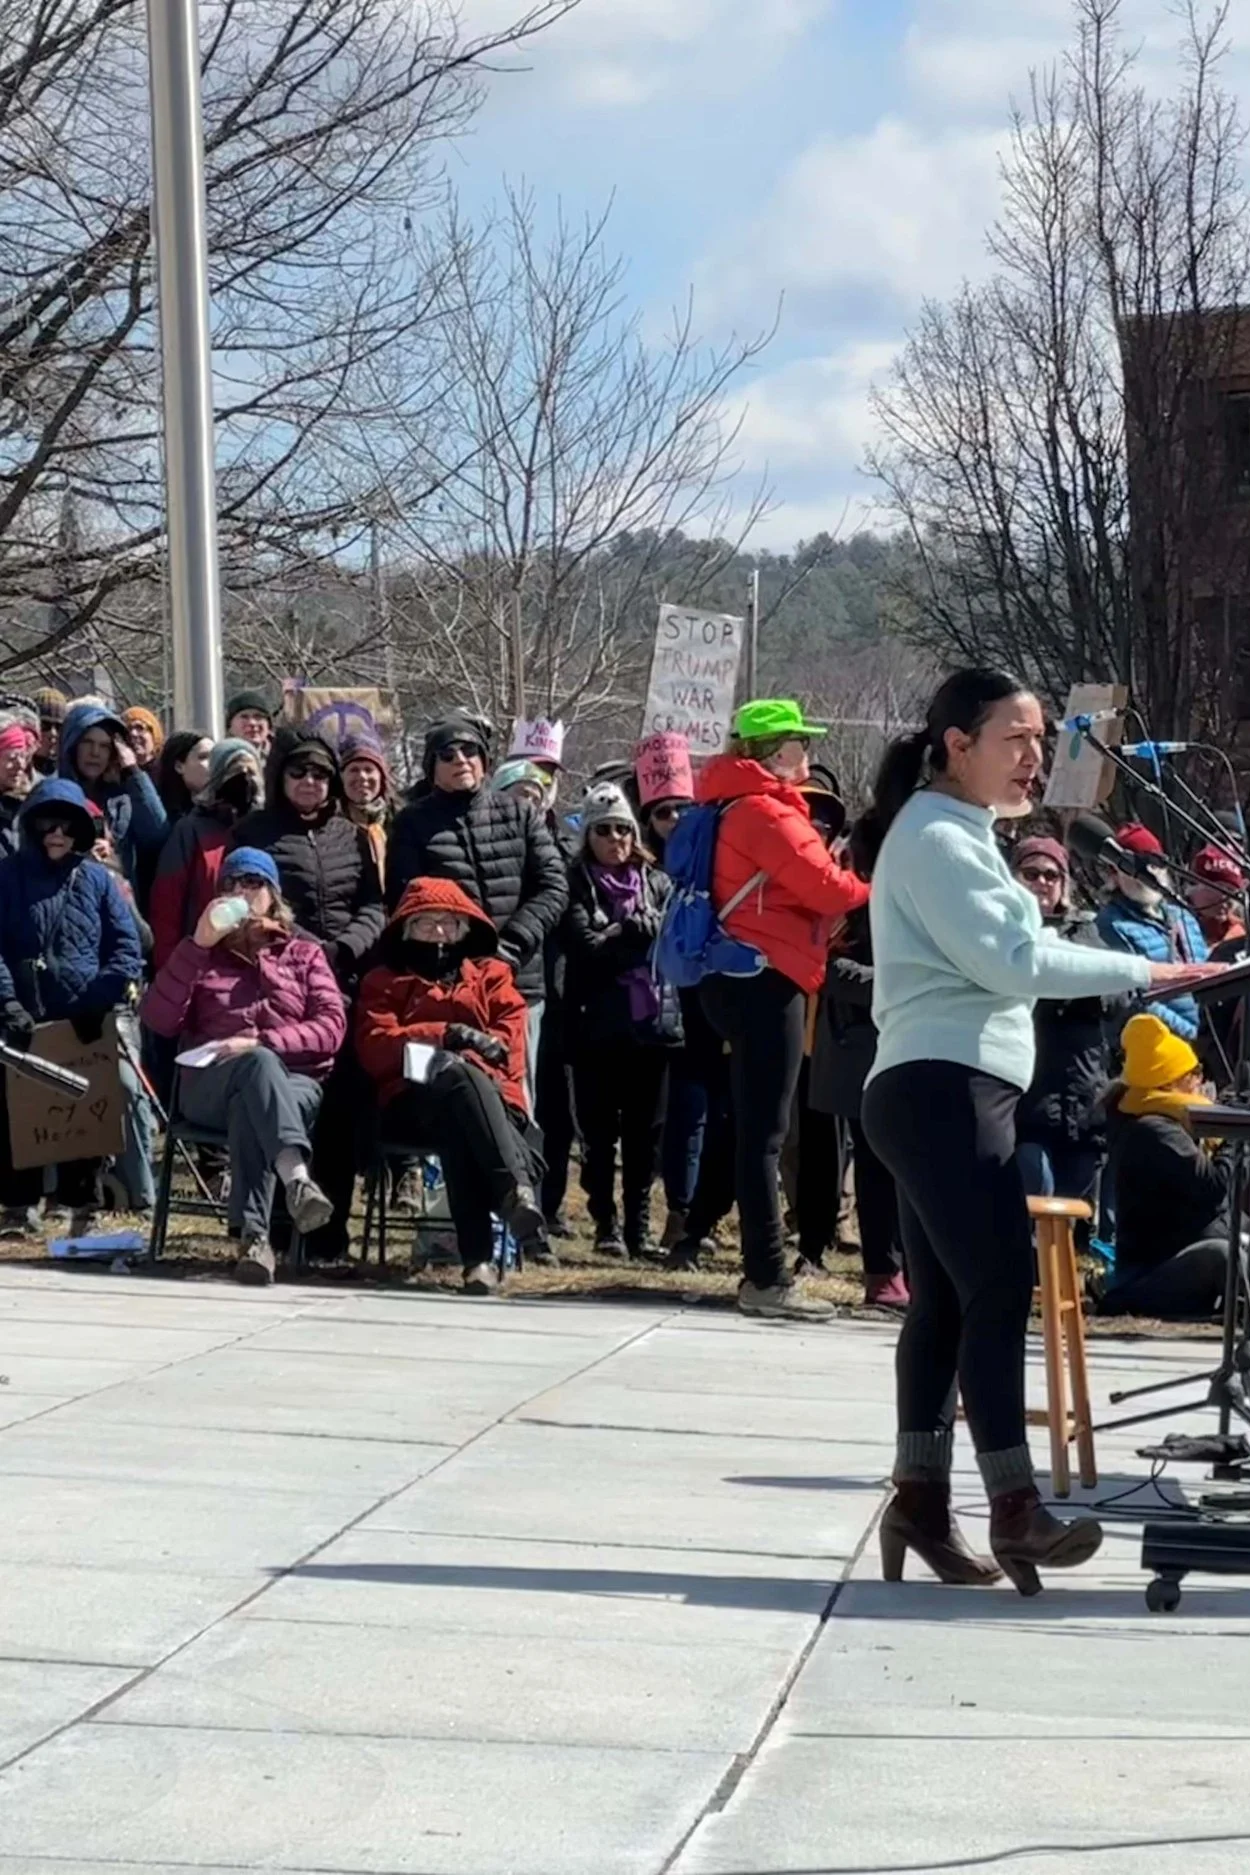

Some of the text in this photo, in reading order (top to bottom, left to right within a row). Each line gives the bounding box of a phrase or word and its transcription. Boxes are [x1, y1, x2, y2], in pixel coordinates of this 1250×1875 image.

[664, 614, 734, 647] STOP
[657, 647, 734, 685] TRUMP
[670, 681, 716, 714] WAR
